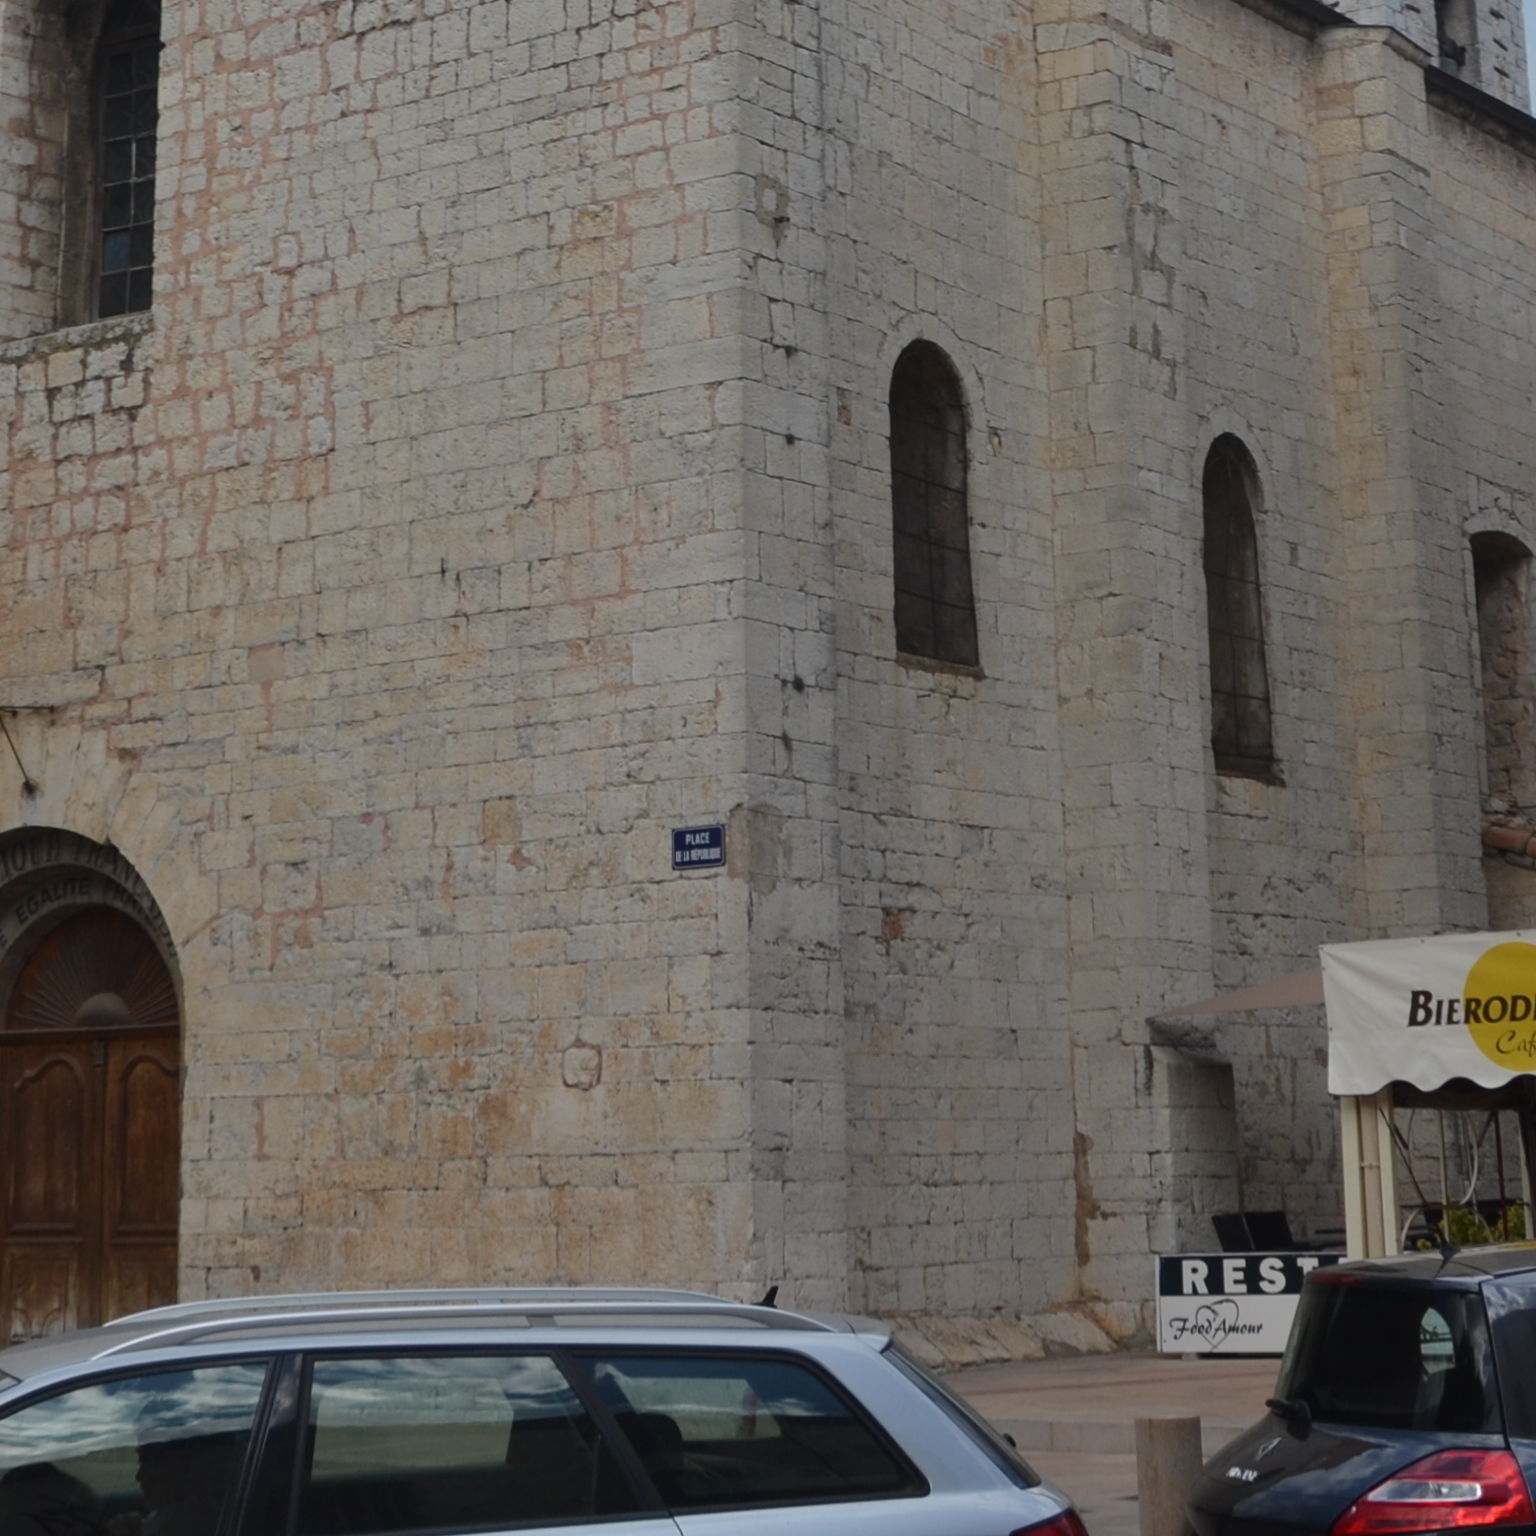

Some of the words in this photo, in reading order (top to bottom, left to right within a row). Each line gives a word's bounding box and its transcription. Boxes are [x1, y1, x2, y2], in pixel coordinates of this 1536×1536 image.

[686, 832, 710, 845] PLACE
[675, 851, 682, 862] DE
[683, 850, 690, 862] LA
[1181, 1256, 1348, 1295] REST
